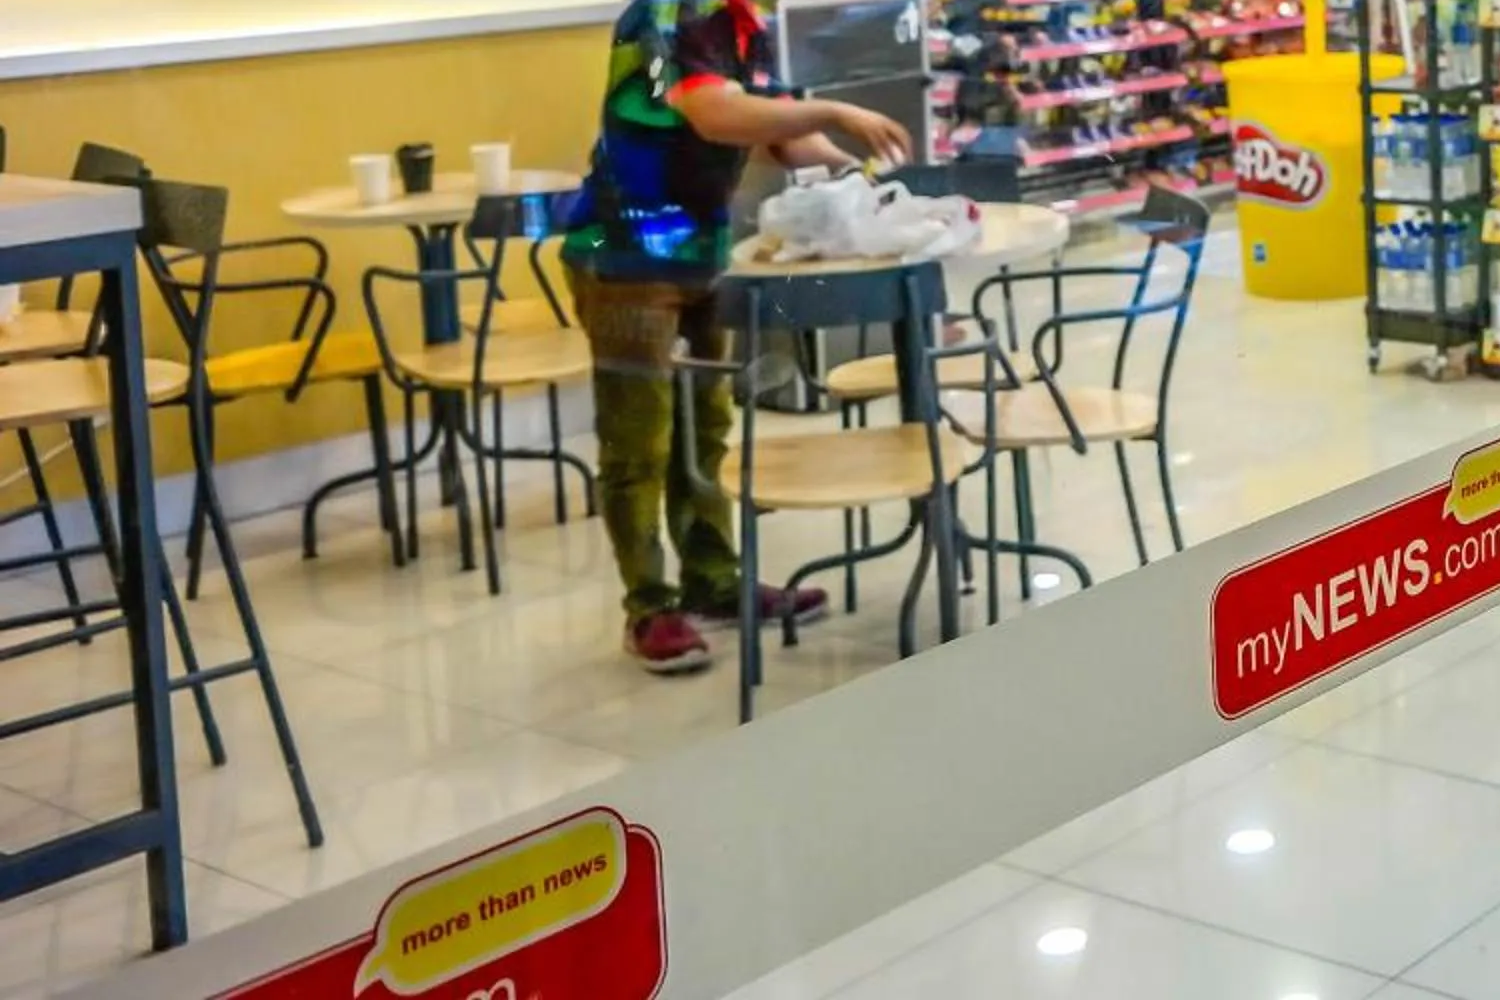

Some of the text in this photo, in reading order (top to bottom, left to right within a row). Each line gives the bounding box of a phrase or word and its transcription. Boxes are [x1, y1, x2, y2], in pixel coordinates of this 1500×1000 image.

[1461, 476, 1489, 499] more
[402, 854, 608, 955] more than news
